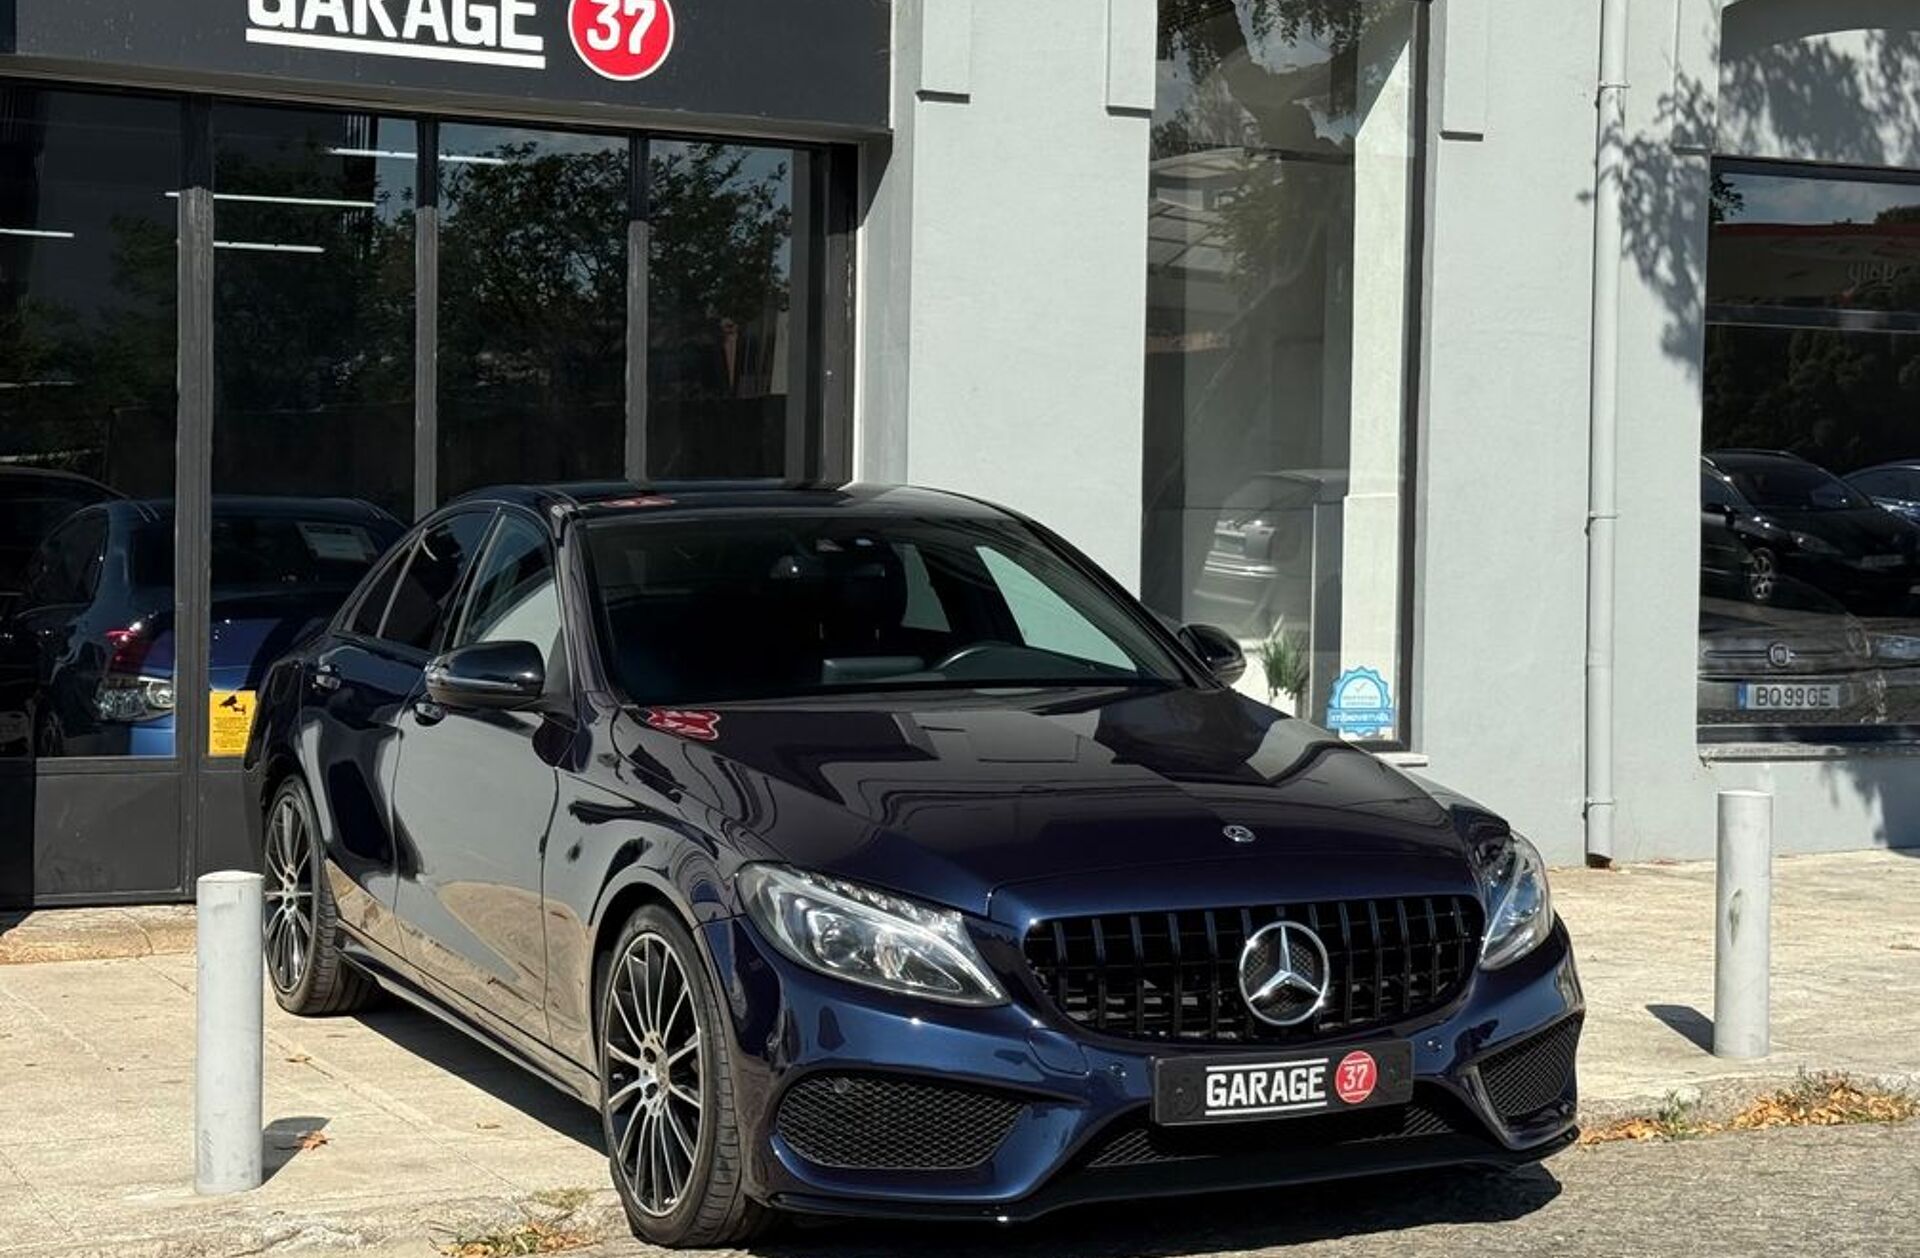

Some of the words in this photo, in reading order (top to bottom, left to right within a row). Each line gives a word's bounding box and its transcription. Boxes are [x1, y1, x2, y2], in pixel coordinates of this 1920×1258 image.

[586, 0, 657, 55] 37
[1206, 1065, 1326, 1107] GARAGE
[1343, 1063, 1368, 1091] 37
